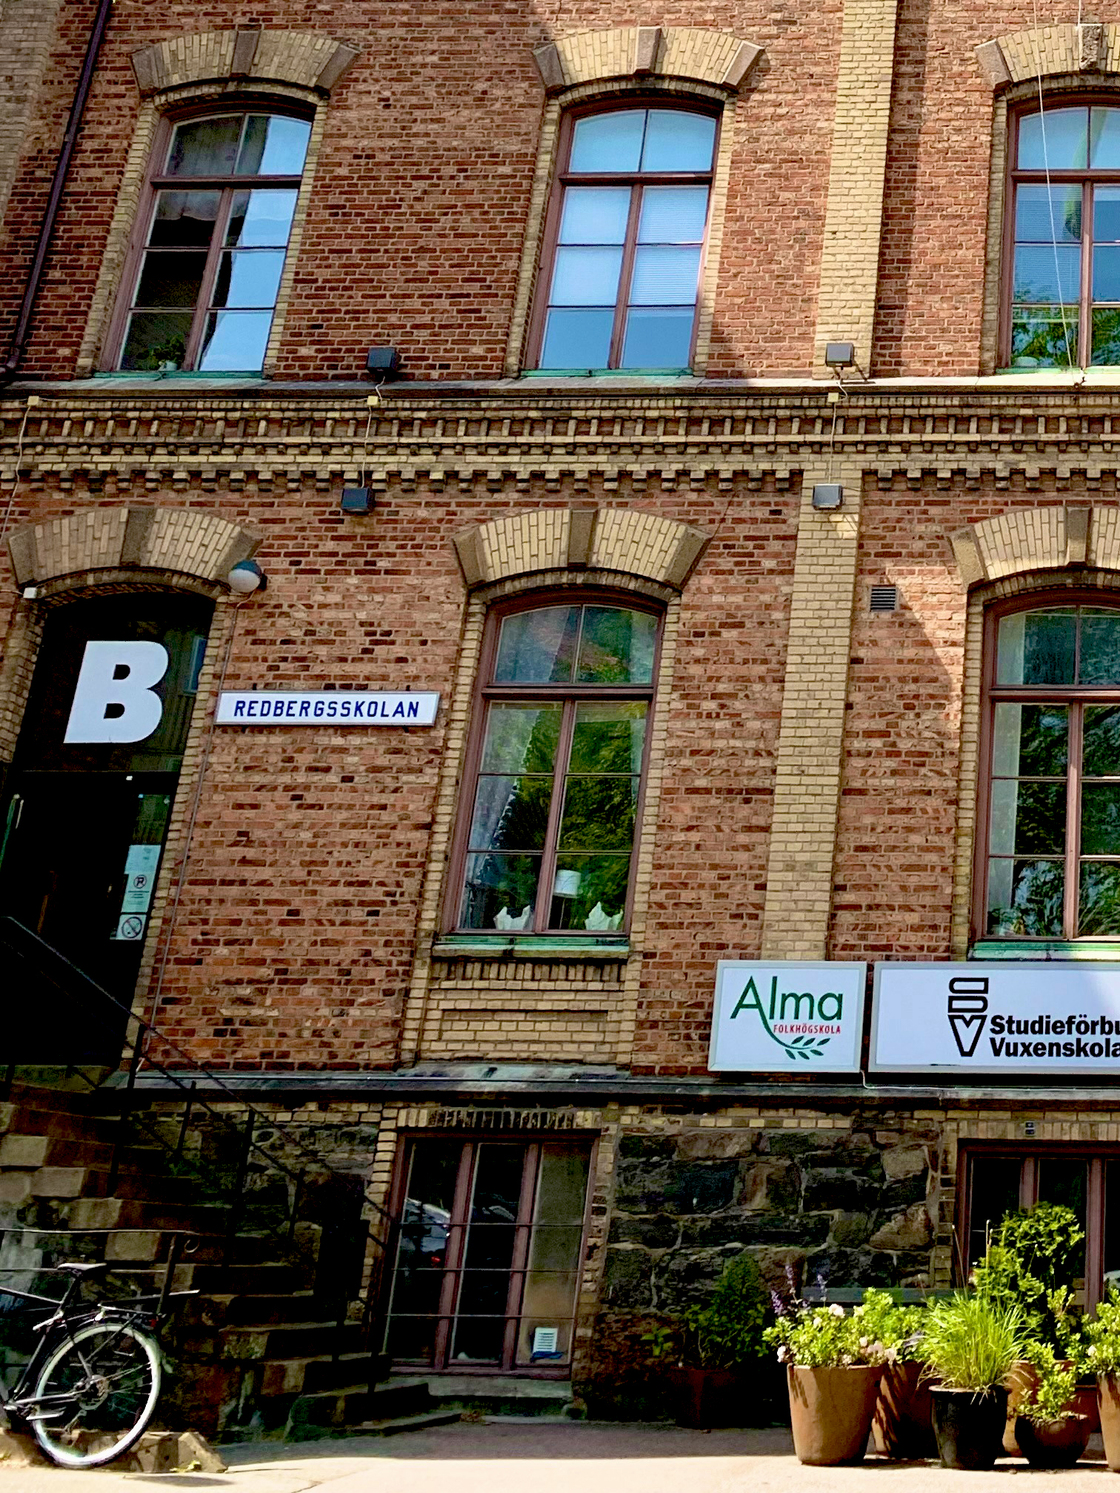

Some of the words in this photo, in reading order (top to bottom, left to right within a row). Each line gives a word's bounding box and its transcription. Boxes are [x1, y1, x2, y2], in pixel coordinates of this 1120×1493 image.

[64, 641, 168, 744] B
[233, 700, 419, 718] REDBERGSSKOLAN
[730, 975, 843, 1021] Alma
[773, 1022, 841, 1034] FOLKHÖGSKOLA
